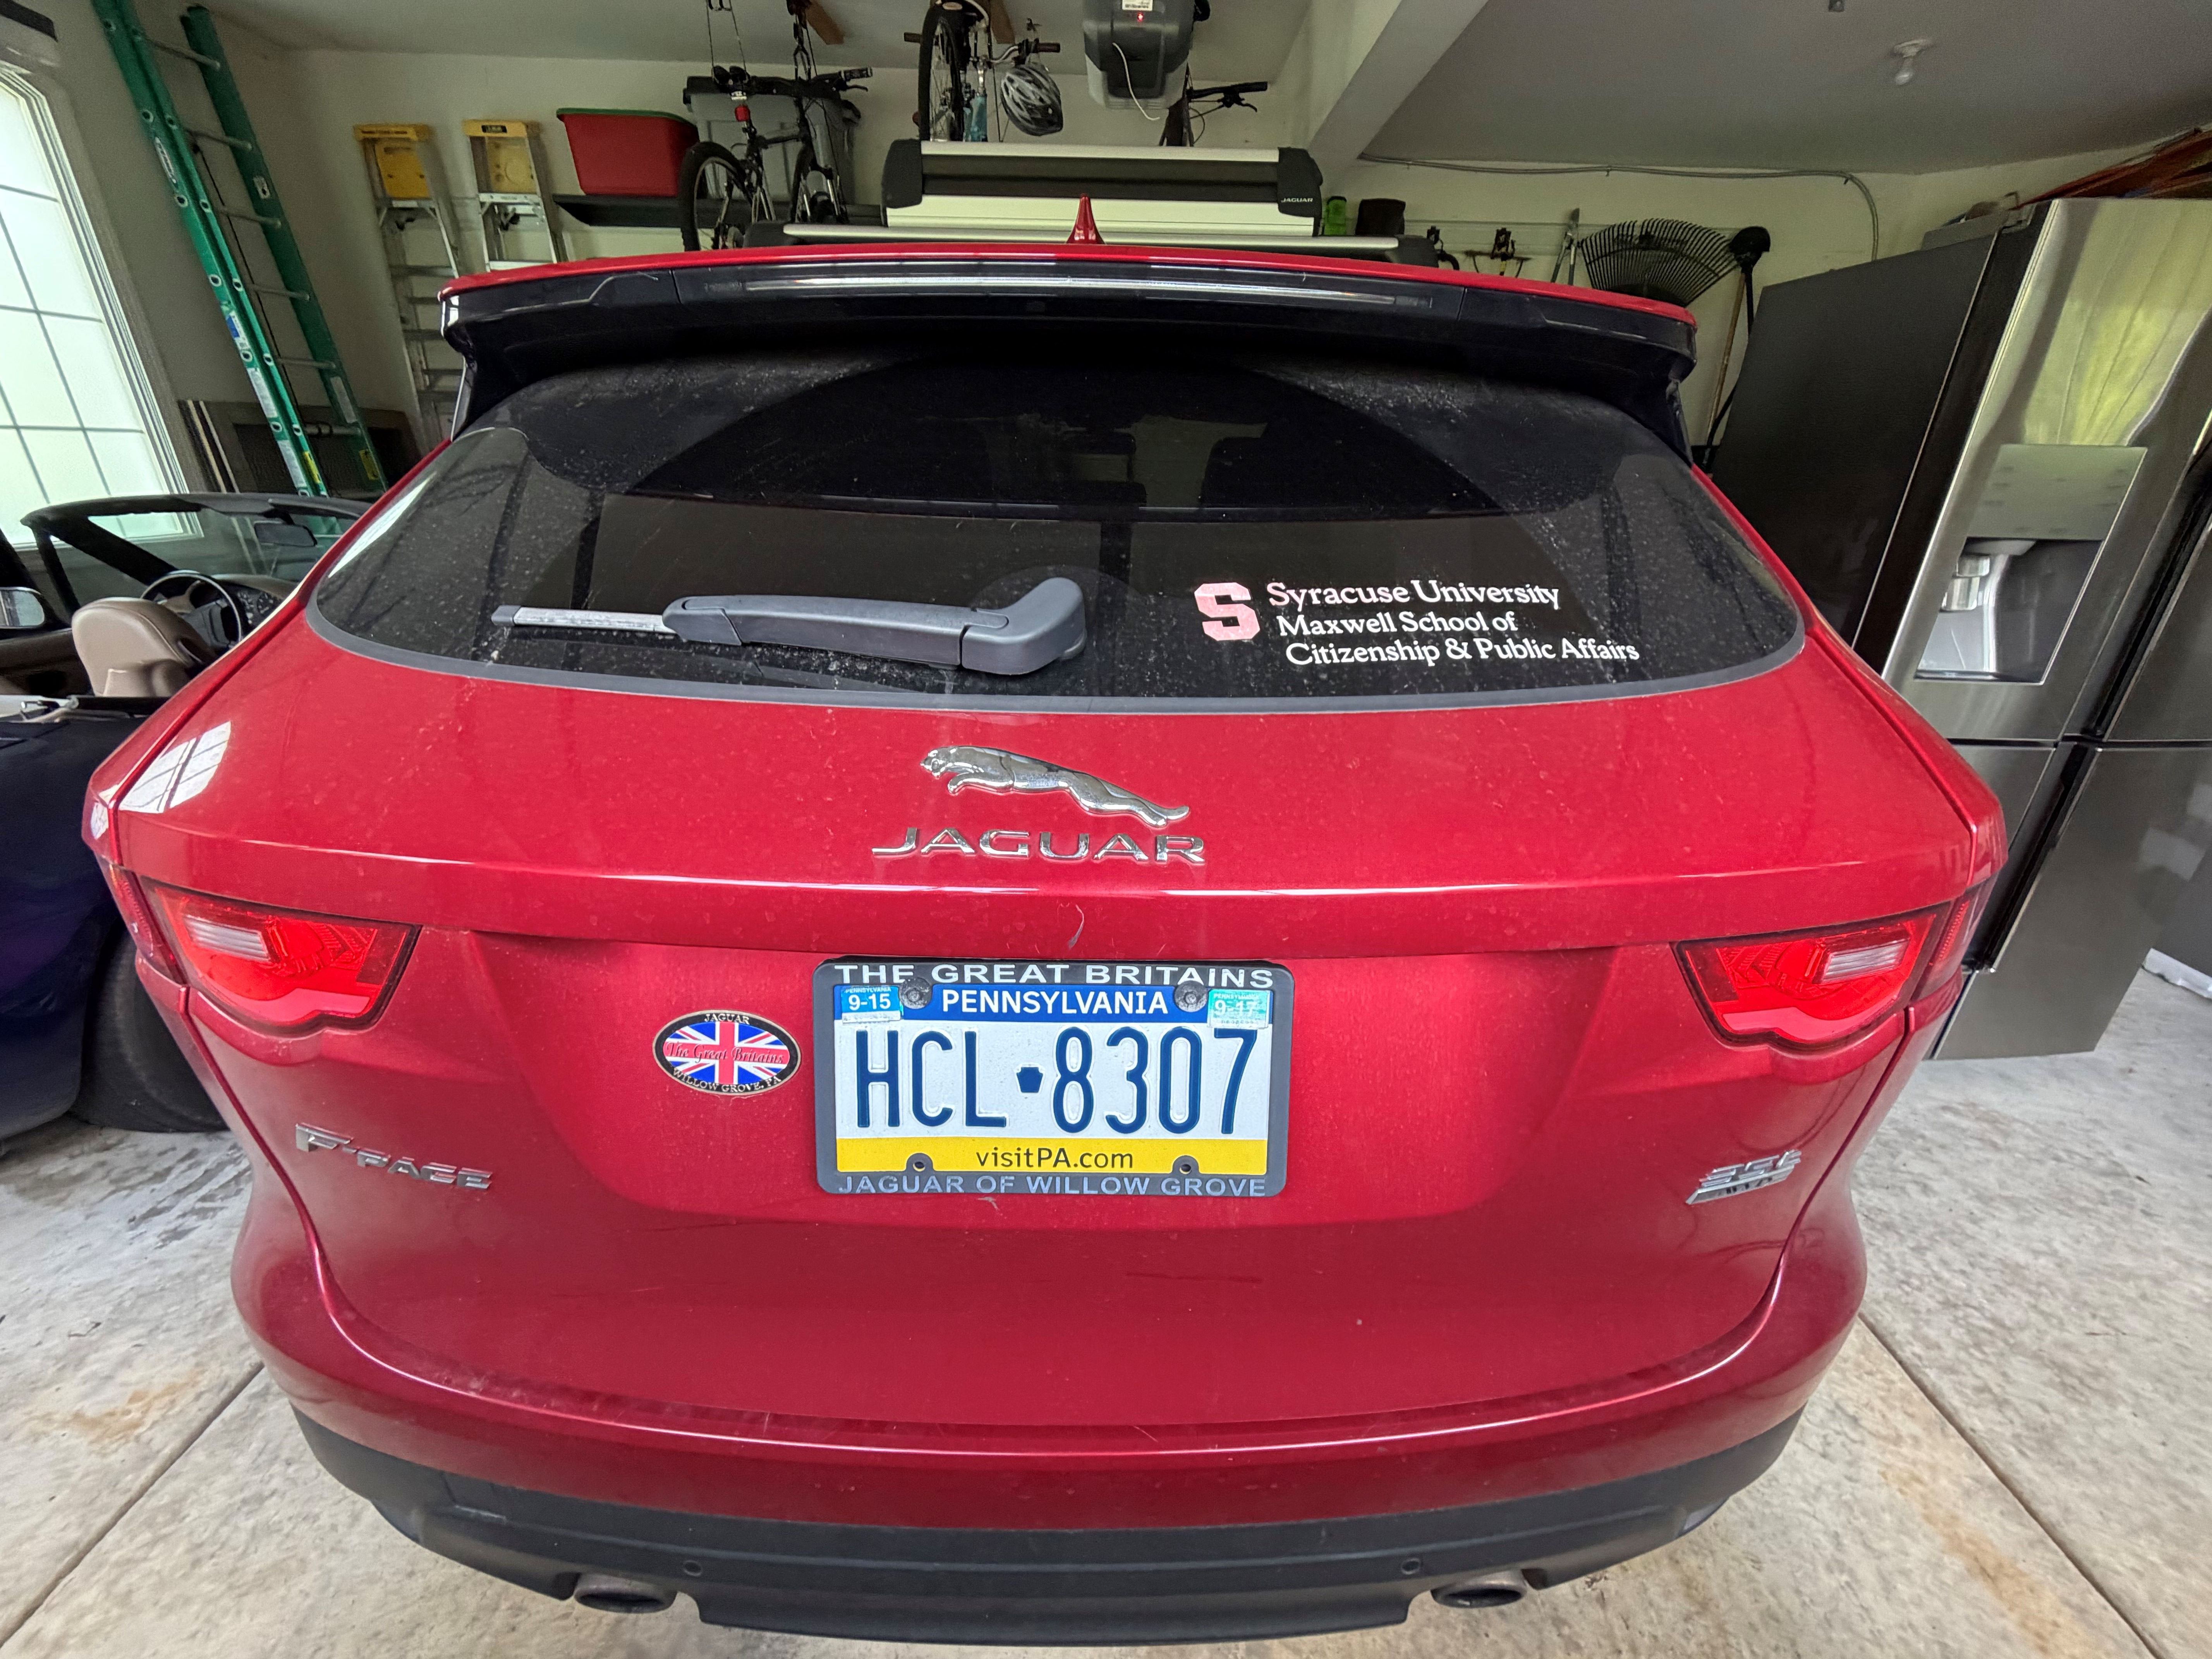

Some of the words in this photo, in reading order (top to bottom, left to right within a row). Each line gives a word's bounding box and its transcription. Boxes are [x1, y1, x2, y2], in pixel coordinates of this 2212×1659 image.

[1267, 582, 1410, 611] Syracuse
[1411, 580, 1559, 610] University
[1276, 612, 1398, 636] Maxwell
[1399, 611, 1489, 632] School
[1492, 611, 1518, 631] of
[1286, 639, 1440, 667] Citizenship
[1444, 638, 1472, 659] &
[1473, 638, 1556, 659] Public
[1561, 638, 1640, 661] Affairs
[872, 827, 1206, 865] JAGUAR
[834, 965, 914, 984] THE
[931, 964, 1070, 983] GREAT
[1086, 965, 1273, 988] BRITAINS
[848, 993, 891, 1011] 9-15
[943, 989, 1168, 1013] PENNSYLVANIA
[1214, 1000, 1258, 1017] 9-17
[704, 1013, 750, 1025] JAGUAR
[666, 1041, 689, 1058] The
[694, 1044, 728, 1063] Great
[731, 1046, 784, 1064] Britains
[673, 1067, 718, 1091] WILLOW
[765, 1076, 781, 1087] PA
[856, 1030, 1007, 1128] HCL
[1053, 1026, 1258, 1135] 8307
[295, 1122, 493, 1189] F-PACE
[977, 1147, 1132, 1168] visitPA.com
[838, 1175, 965, 1194] JAGUAR
[975, 1175, 1015, 1194] OF
[1026, 1176, 1150, 1195] WILLOW
[1161, 1178, 1266, 1197] GROVE
